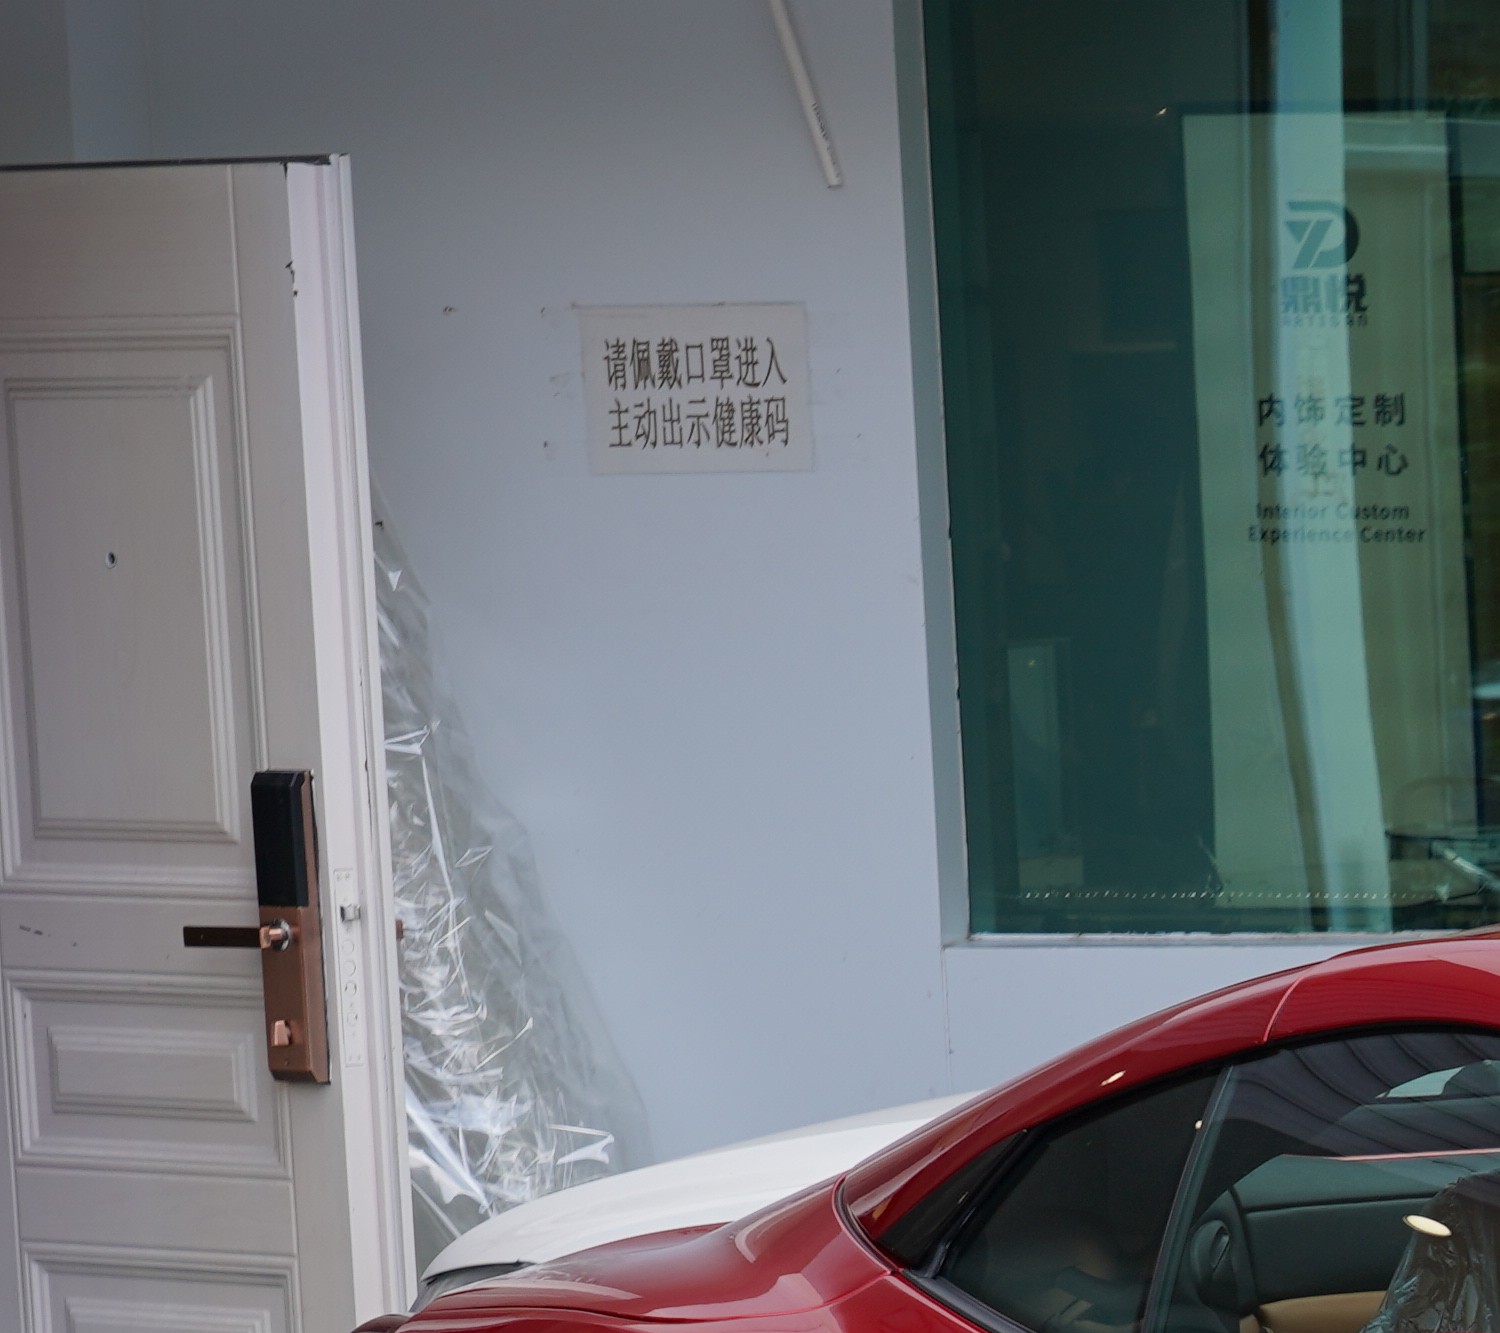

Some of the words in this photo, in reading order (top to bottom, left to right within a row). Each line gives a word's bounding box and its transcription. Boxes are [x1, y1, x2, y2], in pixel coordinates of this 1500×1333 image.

[604, 336, 787, 391] 请佩戴口罩进入
[608, 395, 790, 449] 主动出示健康码
[1258, 393, 1406, 427] 内饰定制
[1259, 442, 1409, 478] 体验中心
[1257, 502, 1326, 520] Interior
[1336, 501, 1410, 520] Custom
[1248, 525, 1353, 545] Experience
[1360, 526, 1427, 543] Center
